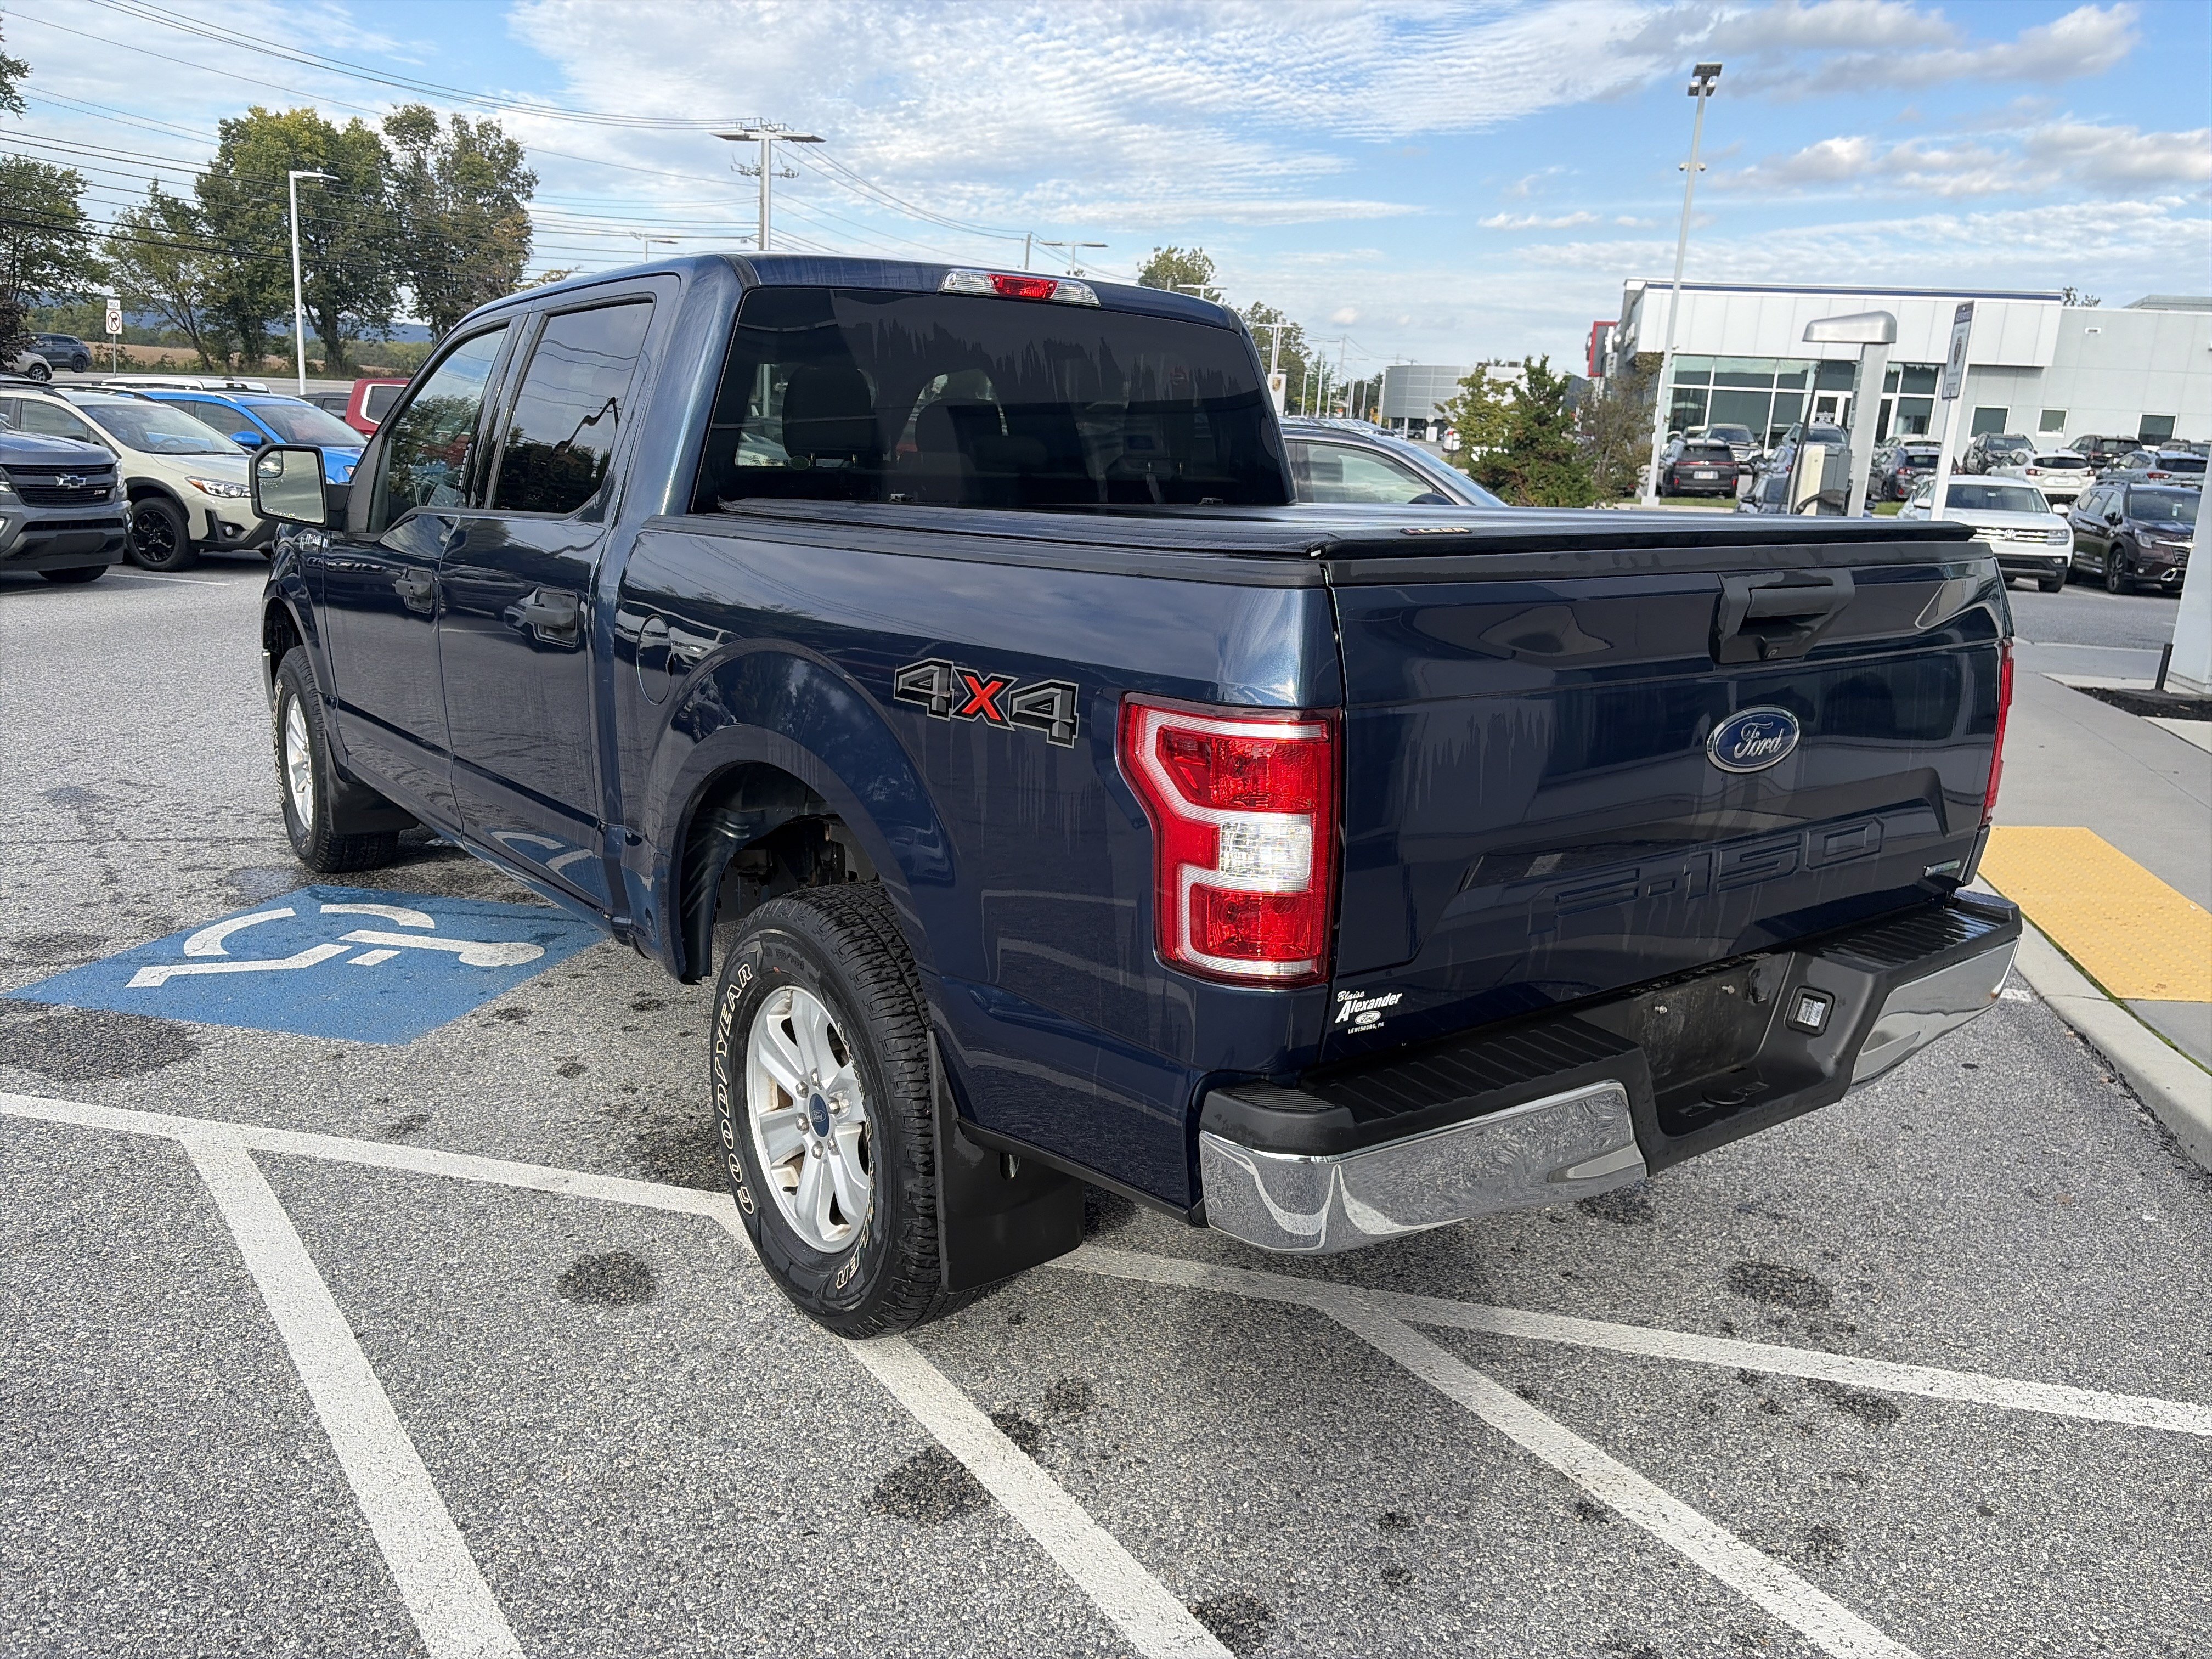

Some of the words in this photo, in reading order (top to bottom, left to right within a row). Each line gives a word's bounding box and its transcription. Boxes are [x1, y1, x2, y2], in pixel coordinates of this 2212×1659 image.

[1734, 721, 1785, 759] Ford
[1336, 990, 1365, 1002] Blaise
[1334, 992, 1403, 1024] Alexander
[1348, 1024, 1377, 1034] LEWISBURG,
[715, 963, 754, 1215] GOODYEAR
[813, 1111, 823, 1120] Ford
